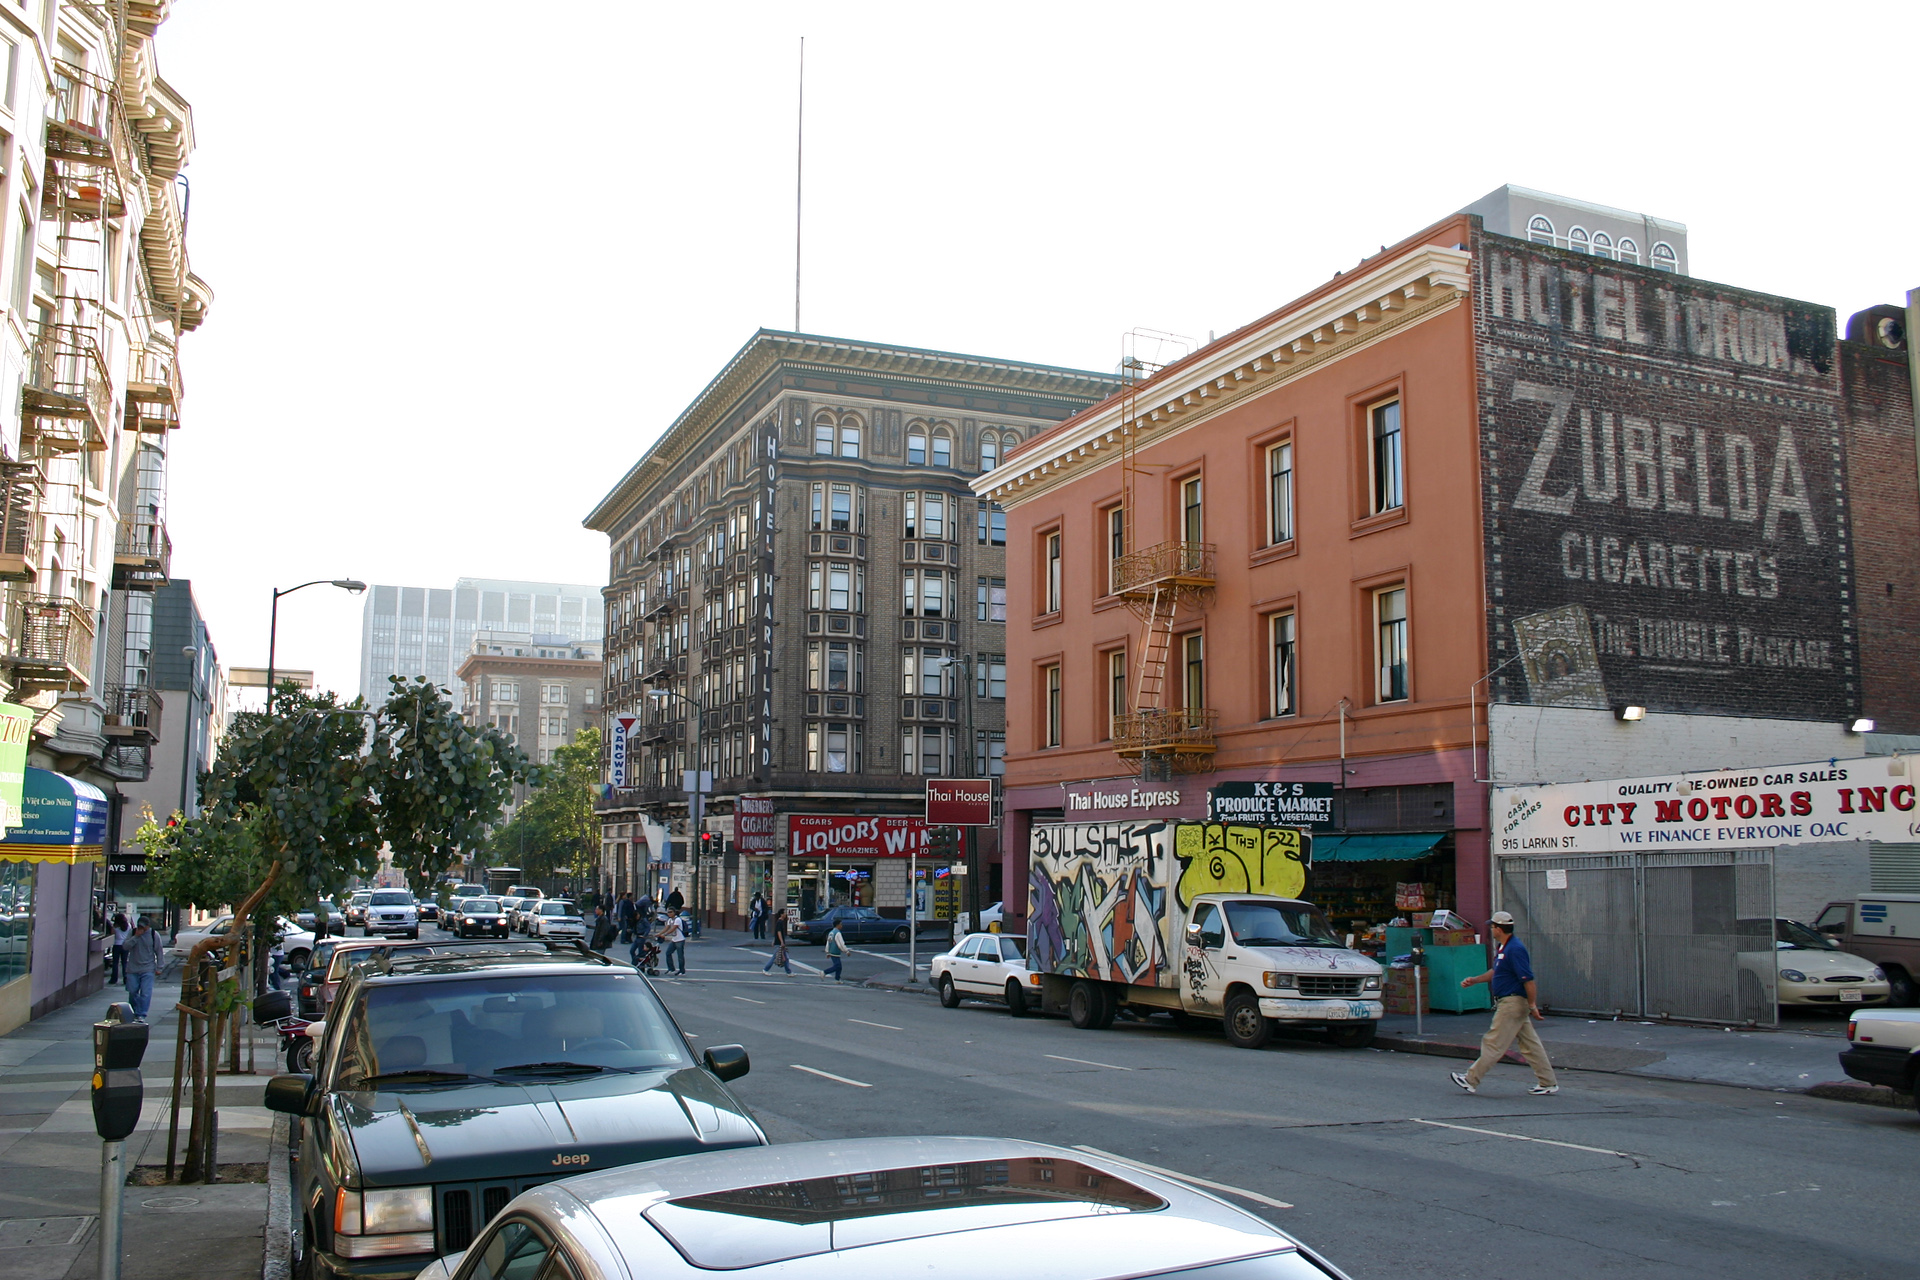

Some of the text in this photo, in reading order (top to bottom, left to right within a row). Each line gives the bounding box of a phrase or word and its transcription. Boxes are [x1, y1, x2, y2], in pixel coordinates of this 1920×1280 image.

[1490, 251, 1654, 346] HOTEL
[1511, 379, 1820, 546] ZUBELDA
[1561, 531, 1779, 599] CIGARETTES
[762, 435, 776, 766] HOTEL HARTLAND
[1638, 617, 1731, 664] DOUBLE
[1737, 624, 1833, 670] PACKAGE
[614, 726, 625, 785] GANGWAY
[1254, 782, 1304, 796] K & S
[1618, 769, 1848, 796] QUALITY RE-OWNED CAR SALES
[41, 798, 55, 806] Cao
[929, 787, 989, 802] Thai House
[1069, 788, 1180, 811] Thai House Express
[1215, 797, 1333, 813] PRODUCE MARKET
[1507, 799, 1528, 819] CASH
[1563, 784, 1916, 827] CITY MOTORS INC
[741, 816, 774, 833] CIGARS
[1218, 813, 1329, 822] Fresh FRUITS & VEGETABLES
[1503, 801, 1542, 834] FOR CARS
[741, 835, 774, 850] LIQUORS
[793, 817, 880, 856] LIQUORS
[1502, 836, 1578, 850] 915 LARKIN ST.
[1620, 822, 1848, 844] WE FINANCE EVERYONE OAC
[835, 847, 879, 855] MAGAZINES
[108, 864, 147, 872] AYS INN
[552, 1153, 590, 1166] Jeep
